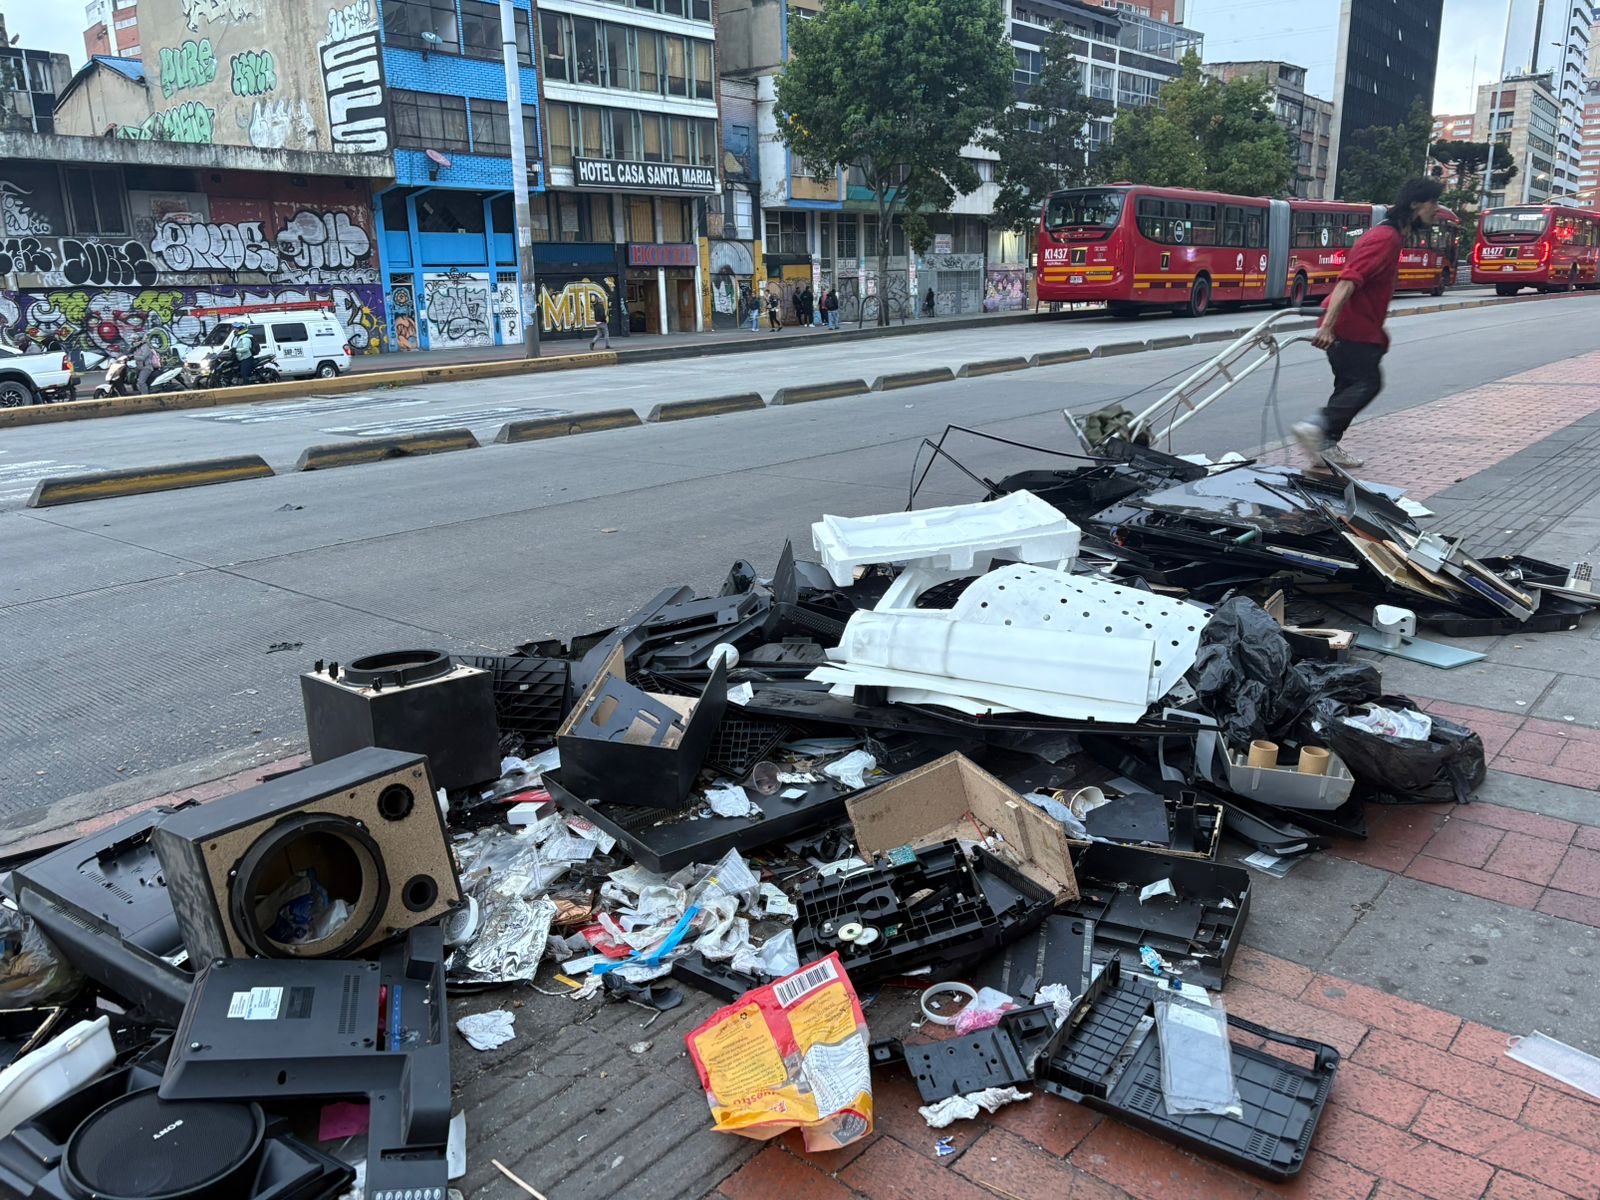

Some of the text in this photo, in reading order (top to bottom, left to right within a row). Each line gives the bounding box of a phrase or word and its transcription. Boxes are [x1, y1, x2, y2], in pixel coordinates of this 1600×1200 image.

[579, 161, 713, 186] HOTEL CASA SANTA MARIA
[632, 245, 692, 265] HOTEL
[1044, 248, 1069, 260] K1437
